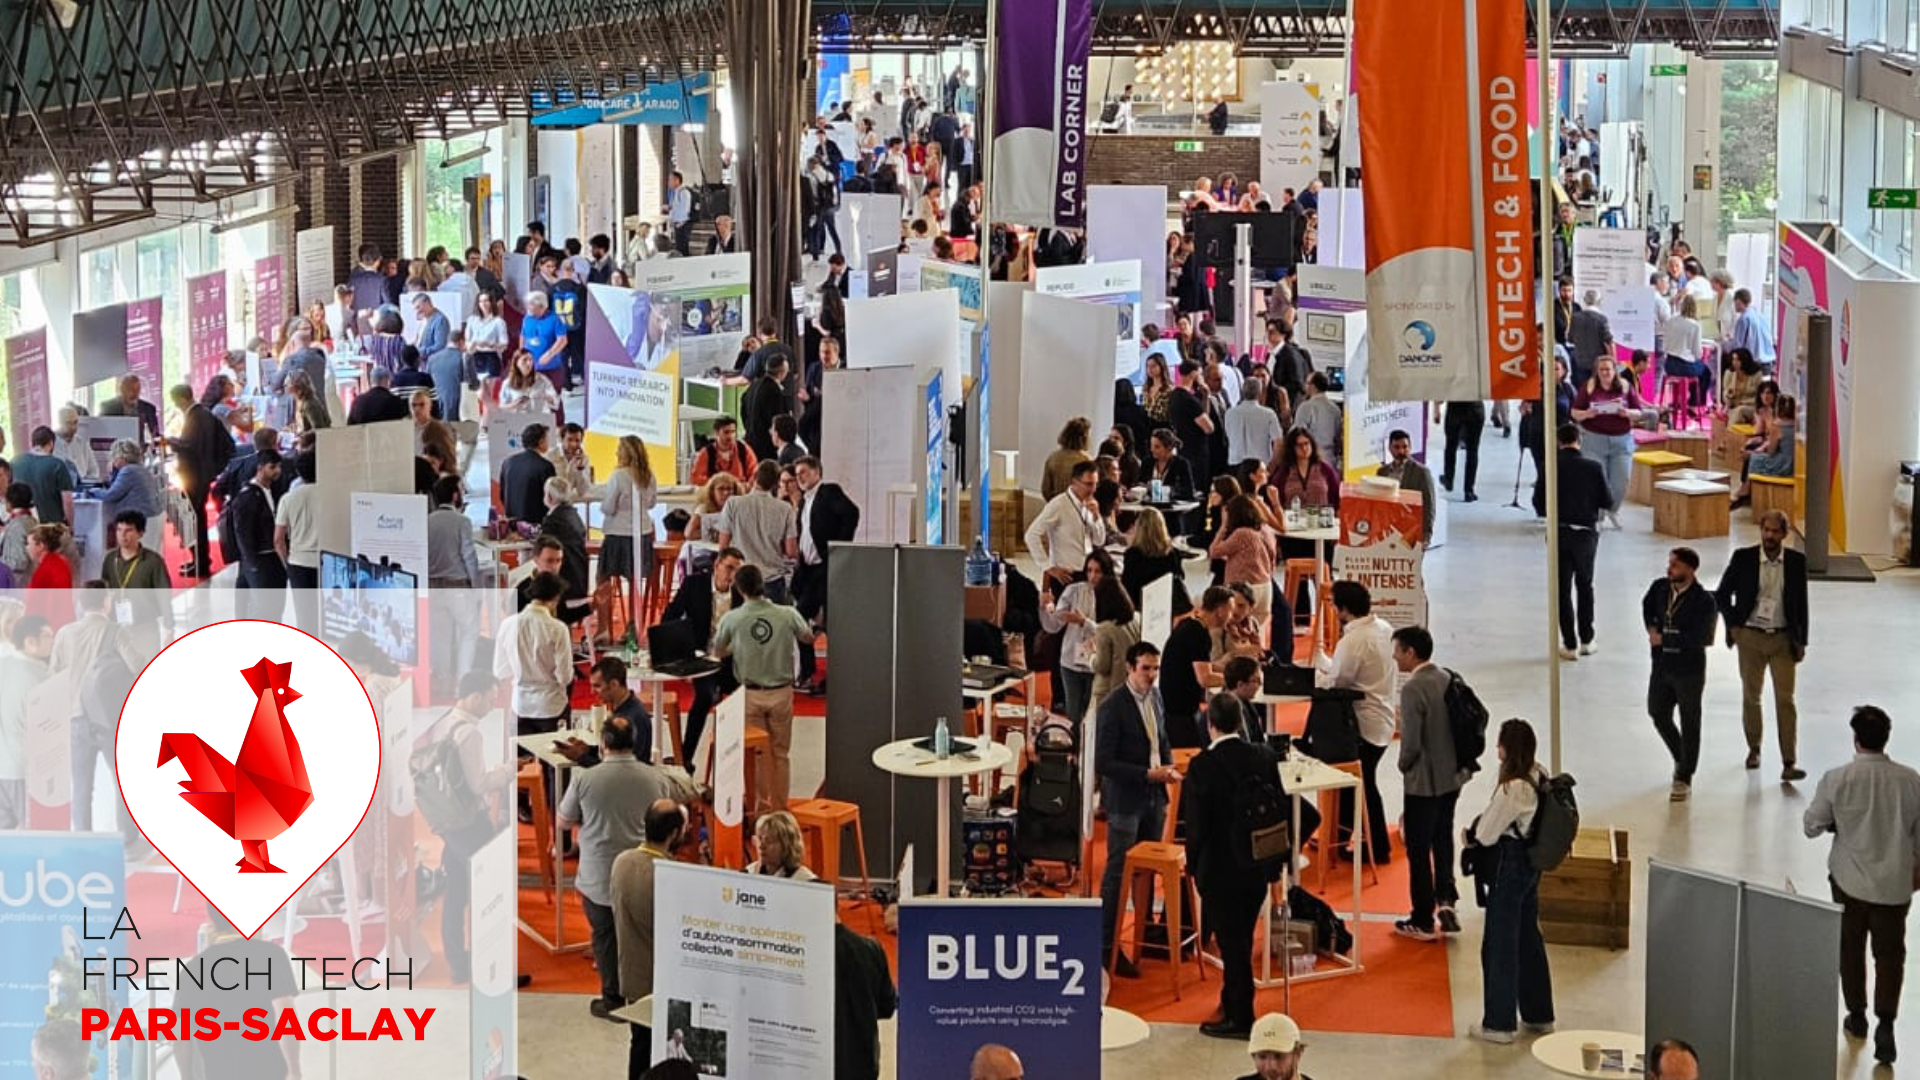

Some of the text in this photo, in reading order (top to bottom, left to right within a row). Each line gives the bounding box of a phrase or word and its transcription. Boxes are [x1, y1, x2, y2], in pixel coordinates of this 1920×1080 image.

[645, 99, 680, 109] ARAGO
[1059, 63, 1083, 216] LAB CORNER
[1490, 76, 1527, 378] AGTECH & FOOD
[1399, 354, 1443, 363] DANONE
[592, 371, 670, 392] TURNING RESEARCH
[597, 386, 665, 407] INTO INNOVATION
[1372, 557, 1414, 571] NUTTY
[1358, 573, 1415, 589] INTENSE
[735, 888, 766, 906] jane
[682, 914, 807, 943] Monter une opération
[681, 940, 805, 969] collective simplement
[929, 1005, 974, 1016] Converting
[976, 1004, 1013, 1015] industrial
[1015, 1005, 1036, 1015] CO2
[1055, 1005, 1076, 1017] high-
[936, 1016, 958, 1026] value
[960, 1016, 996, 1027] products
[998, 1016, 1019, 1027] using
